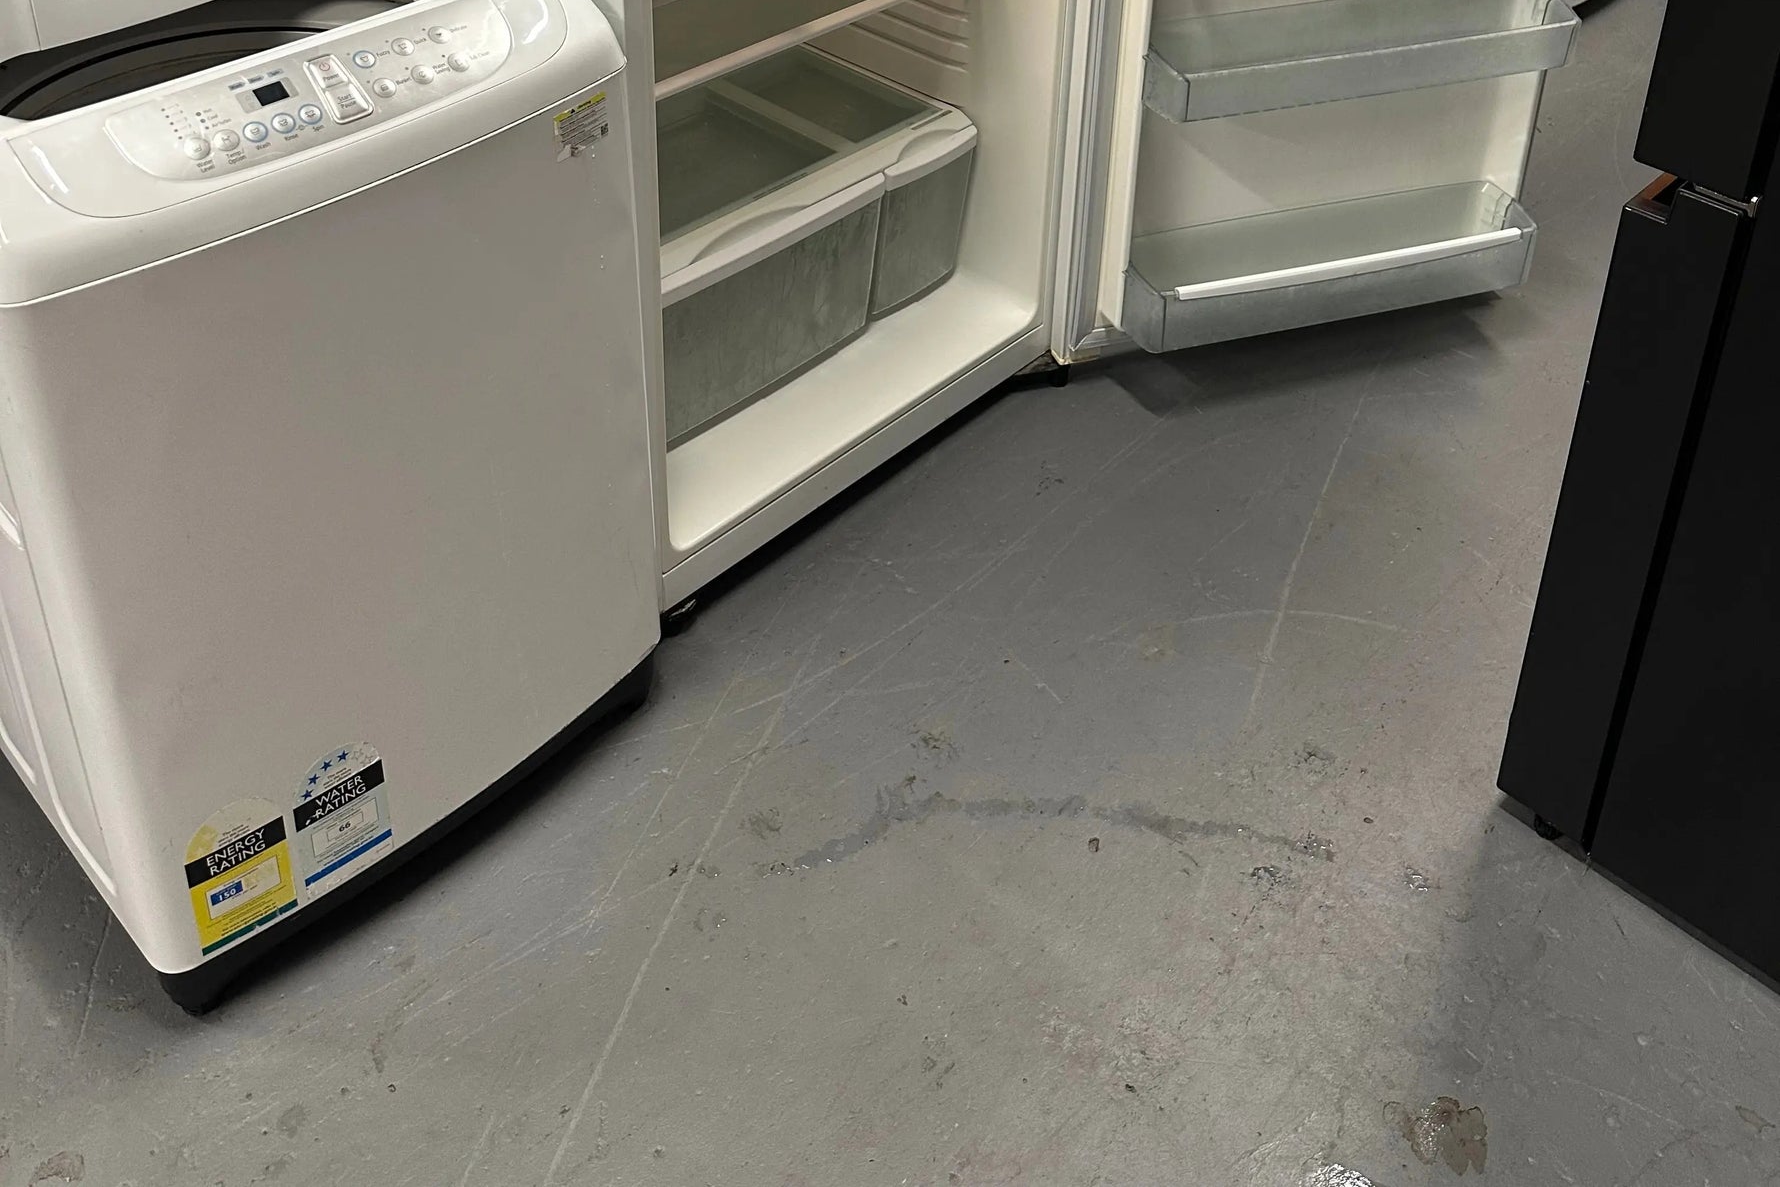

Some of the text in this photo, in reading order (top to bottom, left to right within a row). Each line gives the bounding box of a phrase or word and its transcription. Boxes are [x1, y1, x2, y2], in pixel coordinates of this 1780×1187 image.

[314, 783, 367, 819] RATING
[315, 775, 363, 807] WATER
[339, 821, 351, 832] 66
[206, 828, 265, 867] ENERGY
[210, 840, 266, 876] RATING
[219, 888, 237, 901] 150
